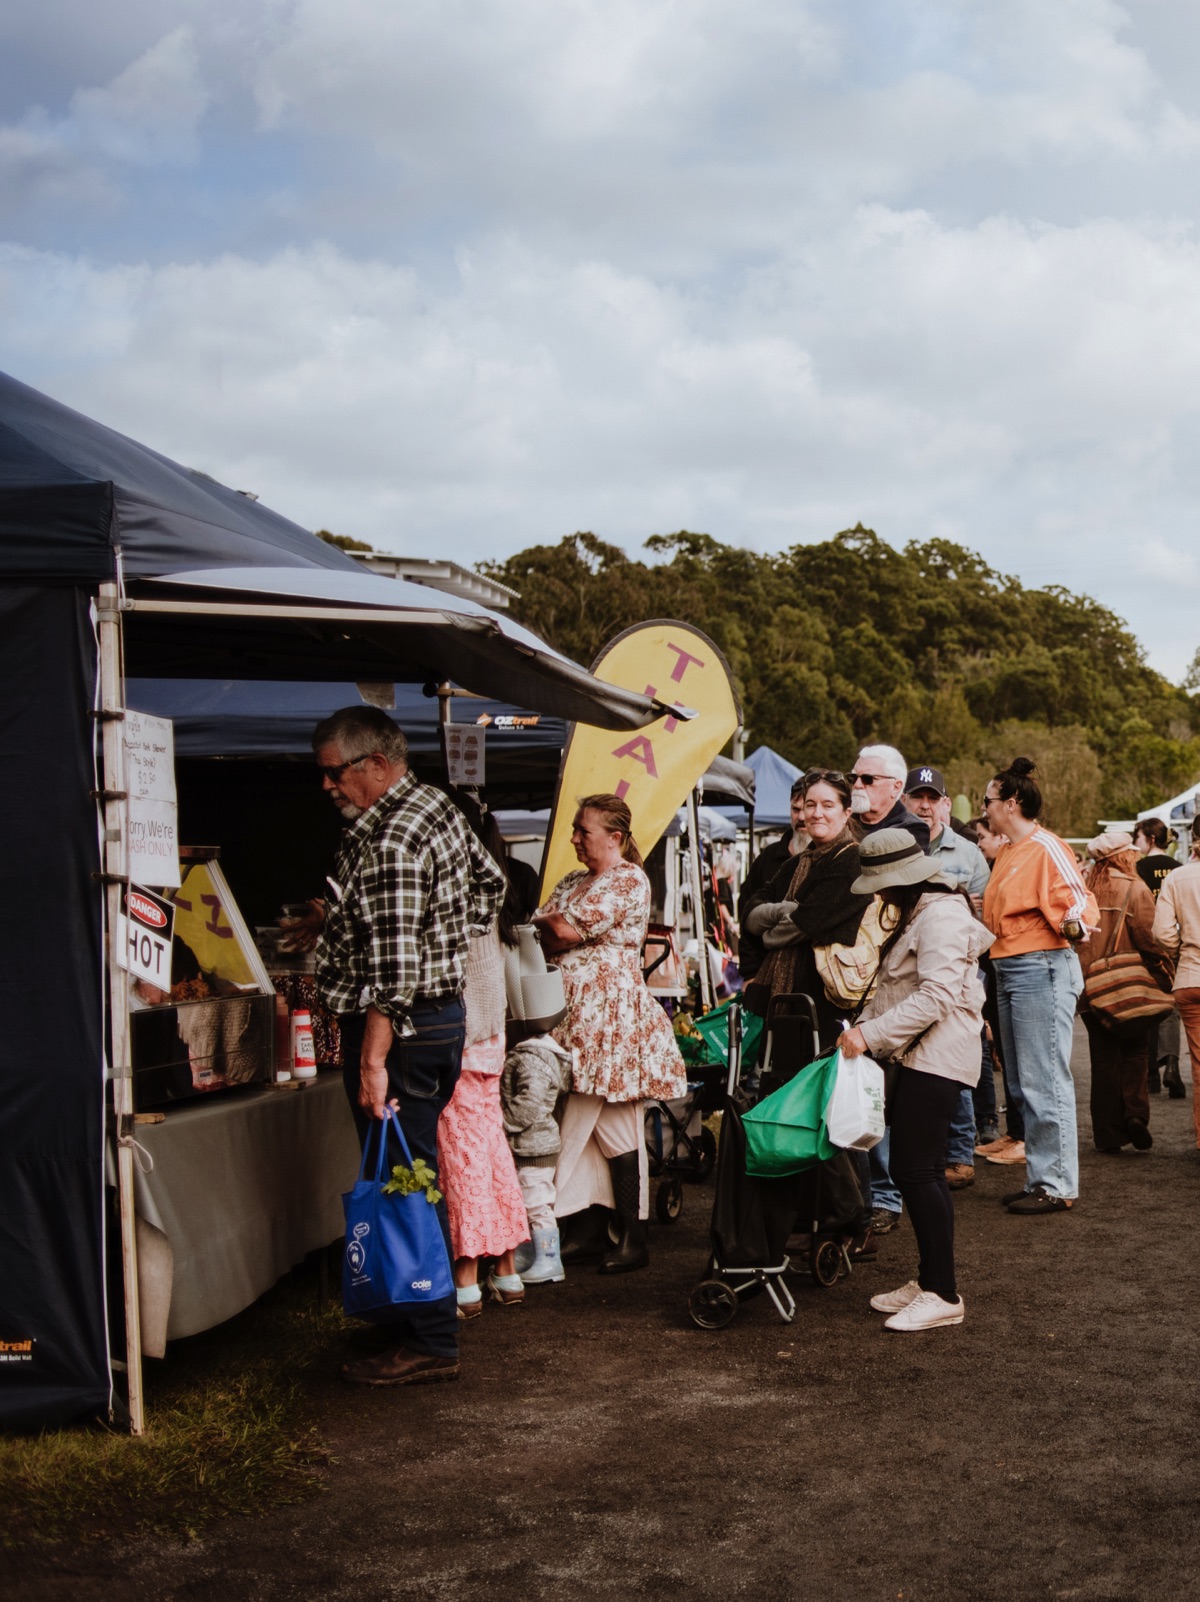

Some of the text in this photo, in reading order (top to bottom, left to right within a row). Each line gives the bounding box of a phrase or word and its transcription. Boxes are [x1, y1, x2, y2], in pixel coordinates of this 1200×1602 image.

[129, 820, 146, 841] orry
[130, 839, 174, 857] ASH ONLY
[130, 895, 162, 925] DANGER
[125, 929, 165, 975] HOT
[411, 1280, 432, 1289] coles
